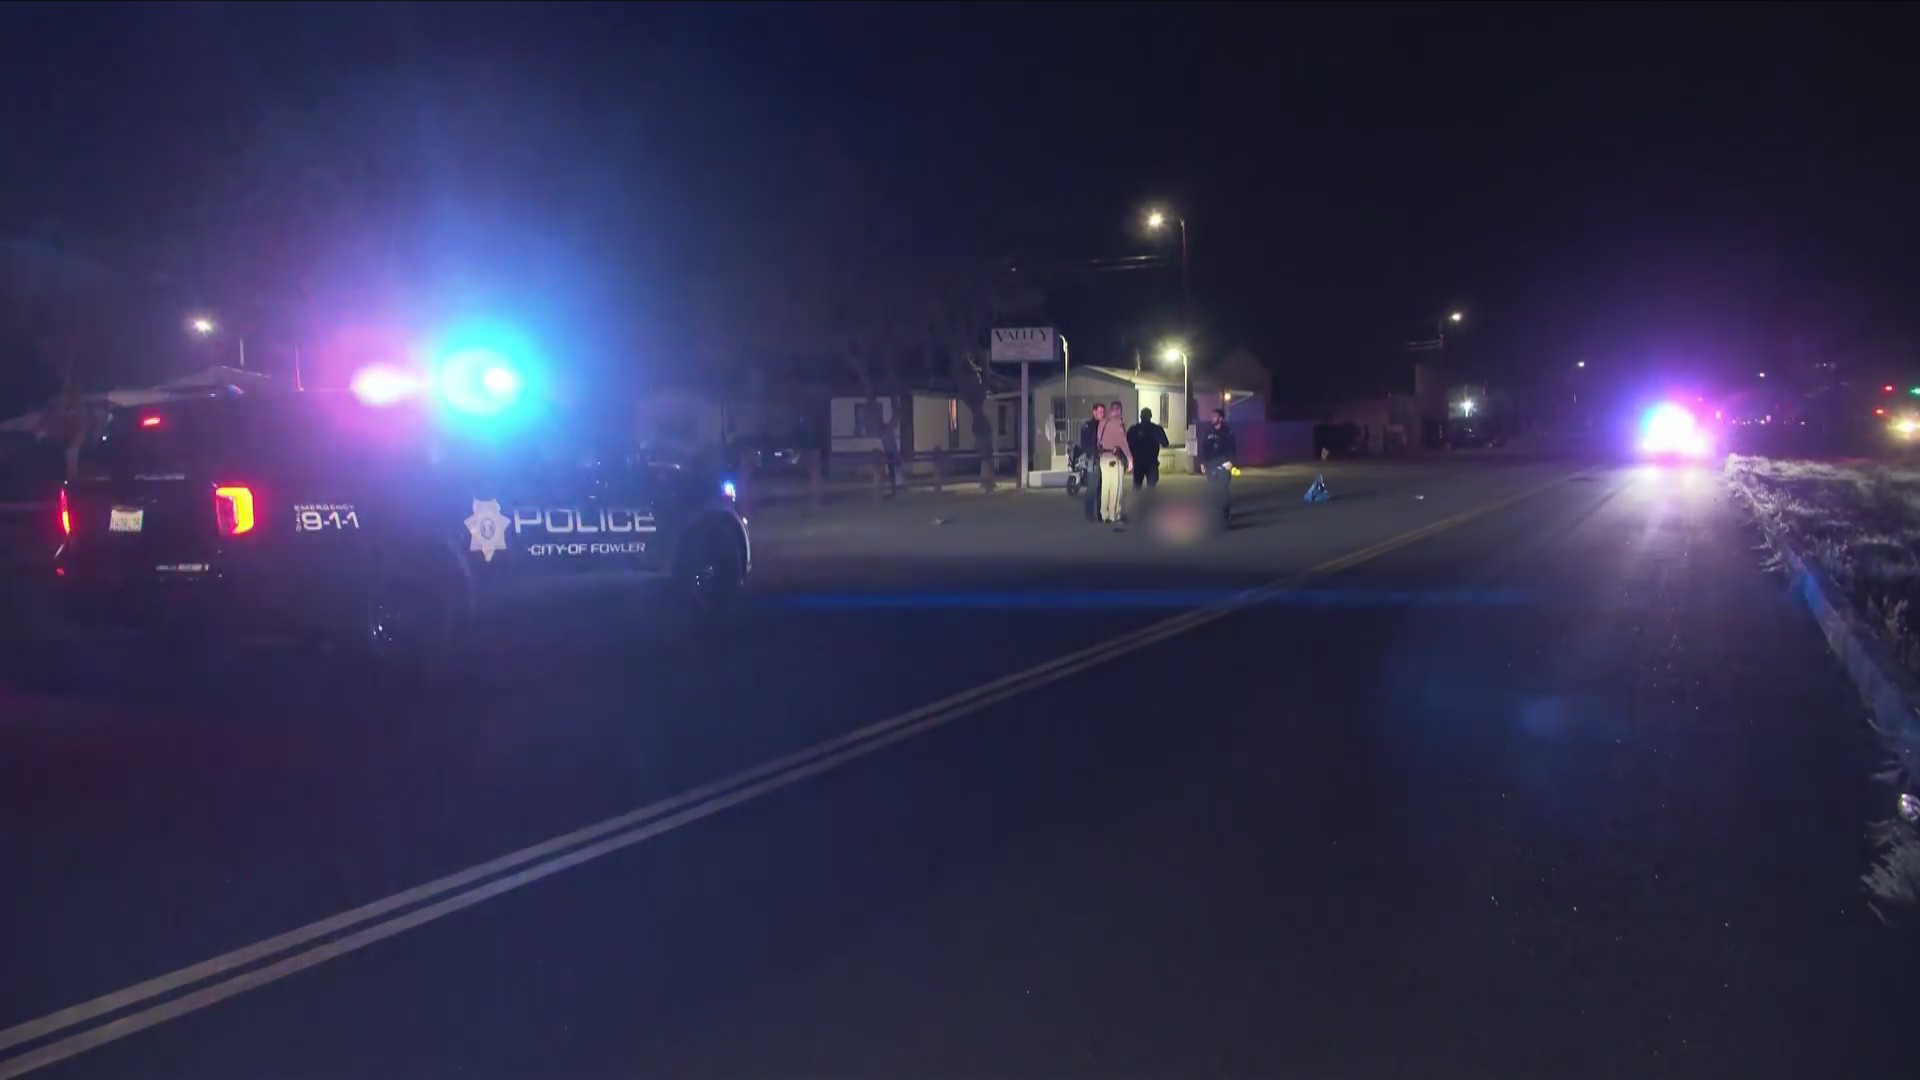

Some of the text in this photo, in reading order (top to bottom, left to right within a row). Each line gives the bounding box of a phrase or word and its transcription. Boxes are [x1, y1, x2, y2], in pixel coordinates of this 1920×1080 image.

[995, 329, 1049, 342] VALLEY
[301, 511, 360, 530] 9-1-1
[513, 509, 657, 534] POLICE
[568, 543, 588, 555] OF
[590, 542, 646, 554] FOWLER
